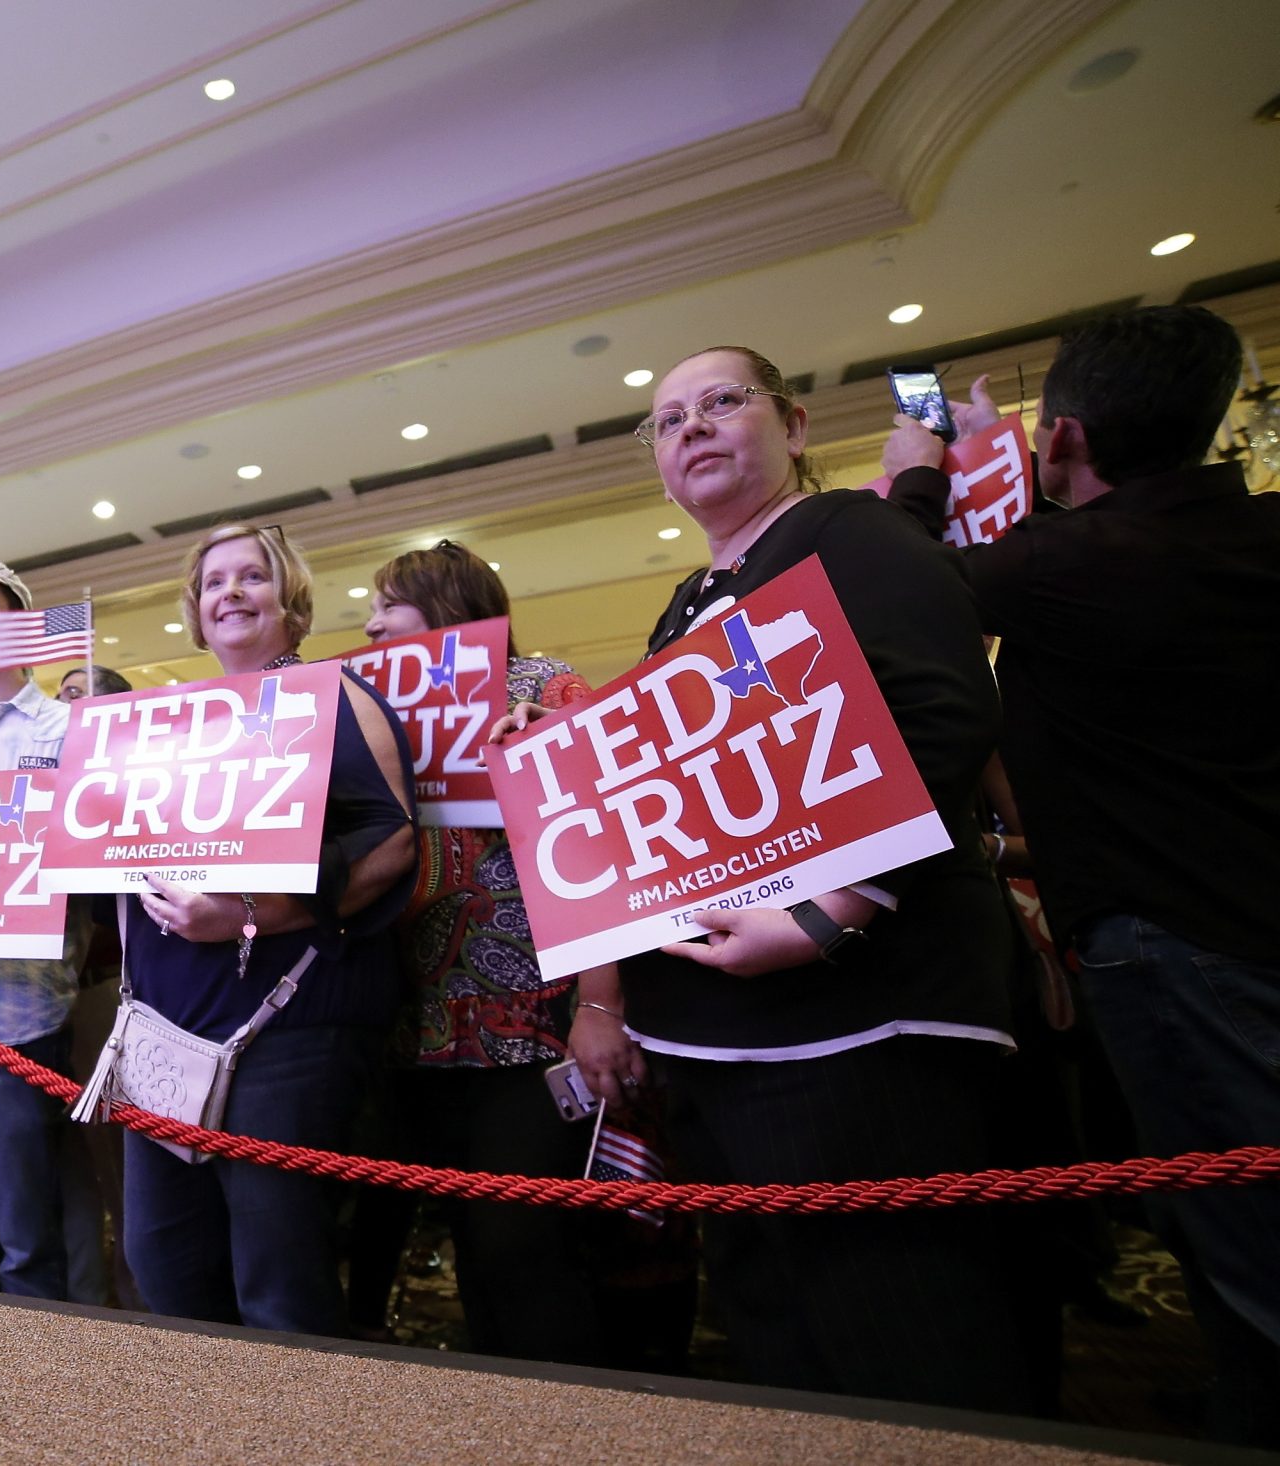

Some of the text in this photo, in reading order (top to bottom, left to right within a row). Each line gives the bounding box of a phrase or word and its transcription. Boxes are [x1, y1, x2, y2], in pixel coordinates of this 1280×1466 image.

[341, 643, 432, 709] ED
[80, 688, 246, 769] TED
[399, 701, 489, 775] UZ
[503, 653, 732, 819] TED
[63, 752, 311, 840] CRUZ
[535, 682, 883, 900] CRUZ
[103, 841, 244, 860] #MAKEDCLISTEN
[627, 823, 823, 911] #MAKEDCLISTEN
[671, 876, 794, 928] TERUZ.ORG
